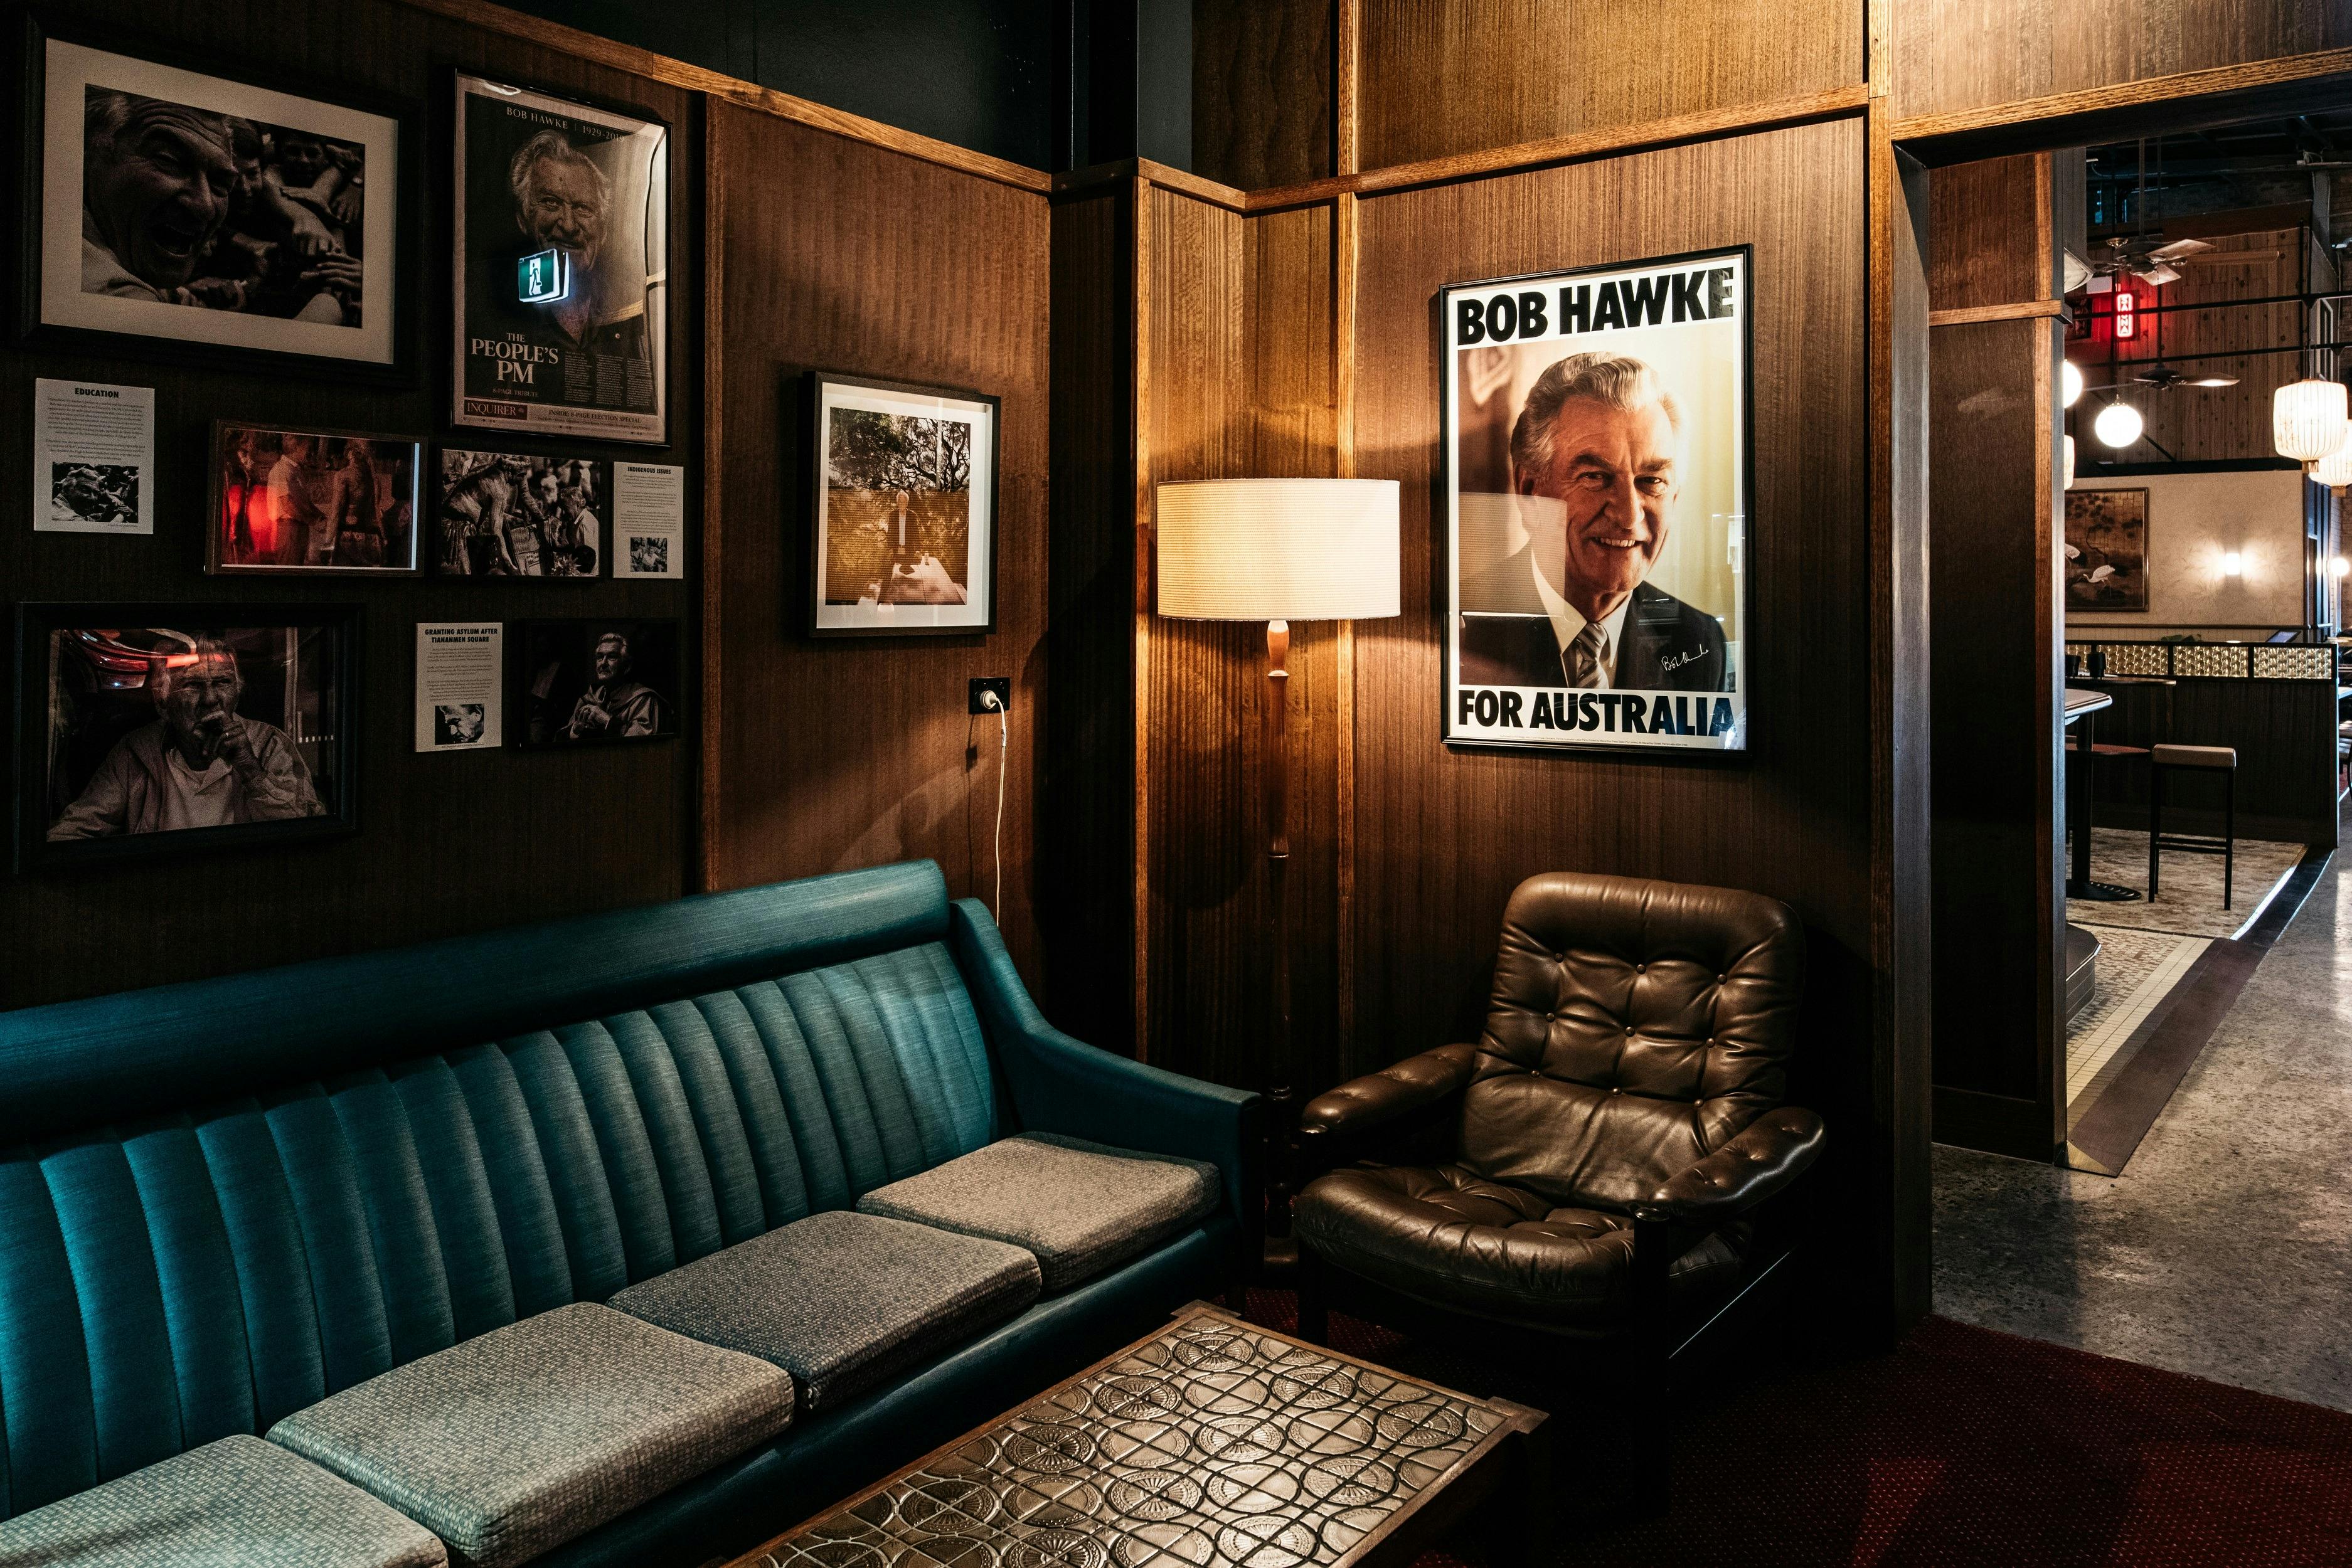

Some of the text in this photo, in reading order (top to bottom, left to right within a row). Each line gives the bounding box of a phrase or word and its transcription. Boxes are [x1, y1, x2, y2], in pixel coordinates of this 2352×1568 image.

[506, 107, 527, 119] BOB
[531, 113, 568, 130] HAWKE
[1457, 267, 1734, 346] BOB HAWKE
[506, 332, 525, 343] THE
[471, 338, 559, 364] PEOPLE'S
[497, 359, 535, 384] PM
[75, 388, 119, 398] EDUCATION
[514, 389, 539, 398] TRIBUTE
[467, 402, 516, 416] INQUIRER
[592, 413, 618, 422] ELECTION
[1458, 689, 1738, 738] FOR AUSTRALIA
